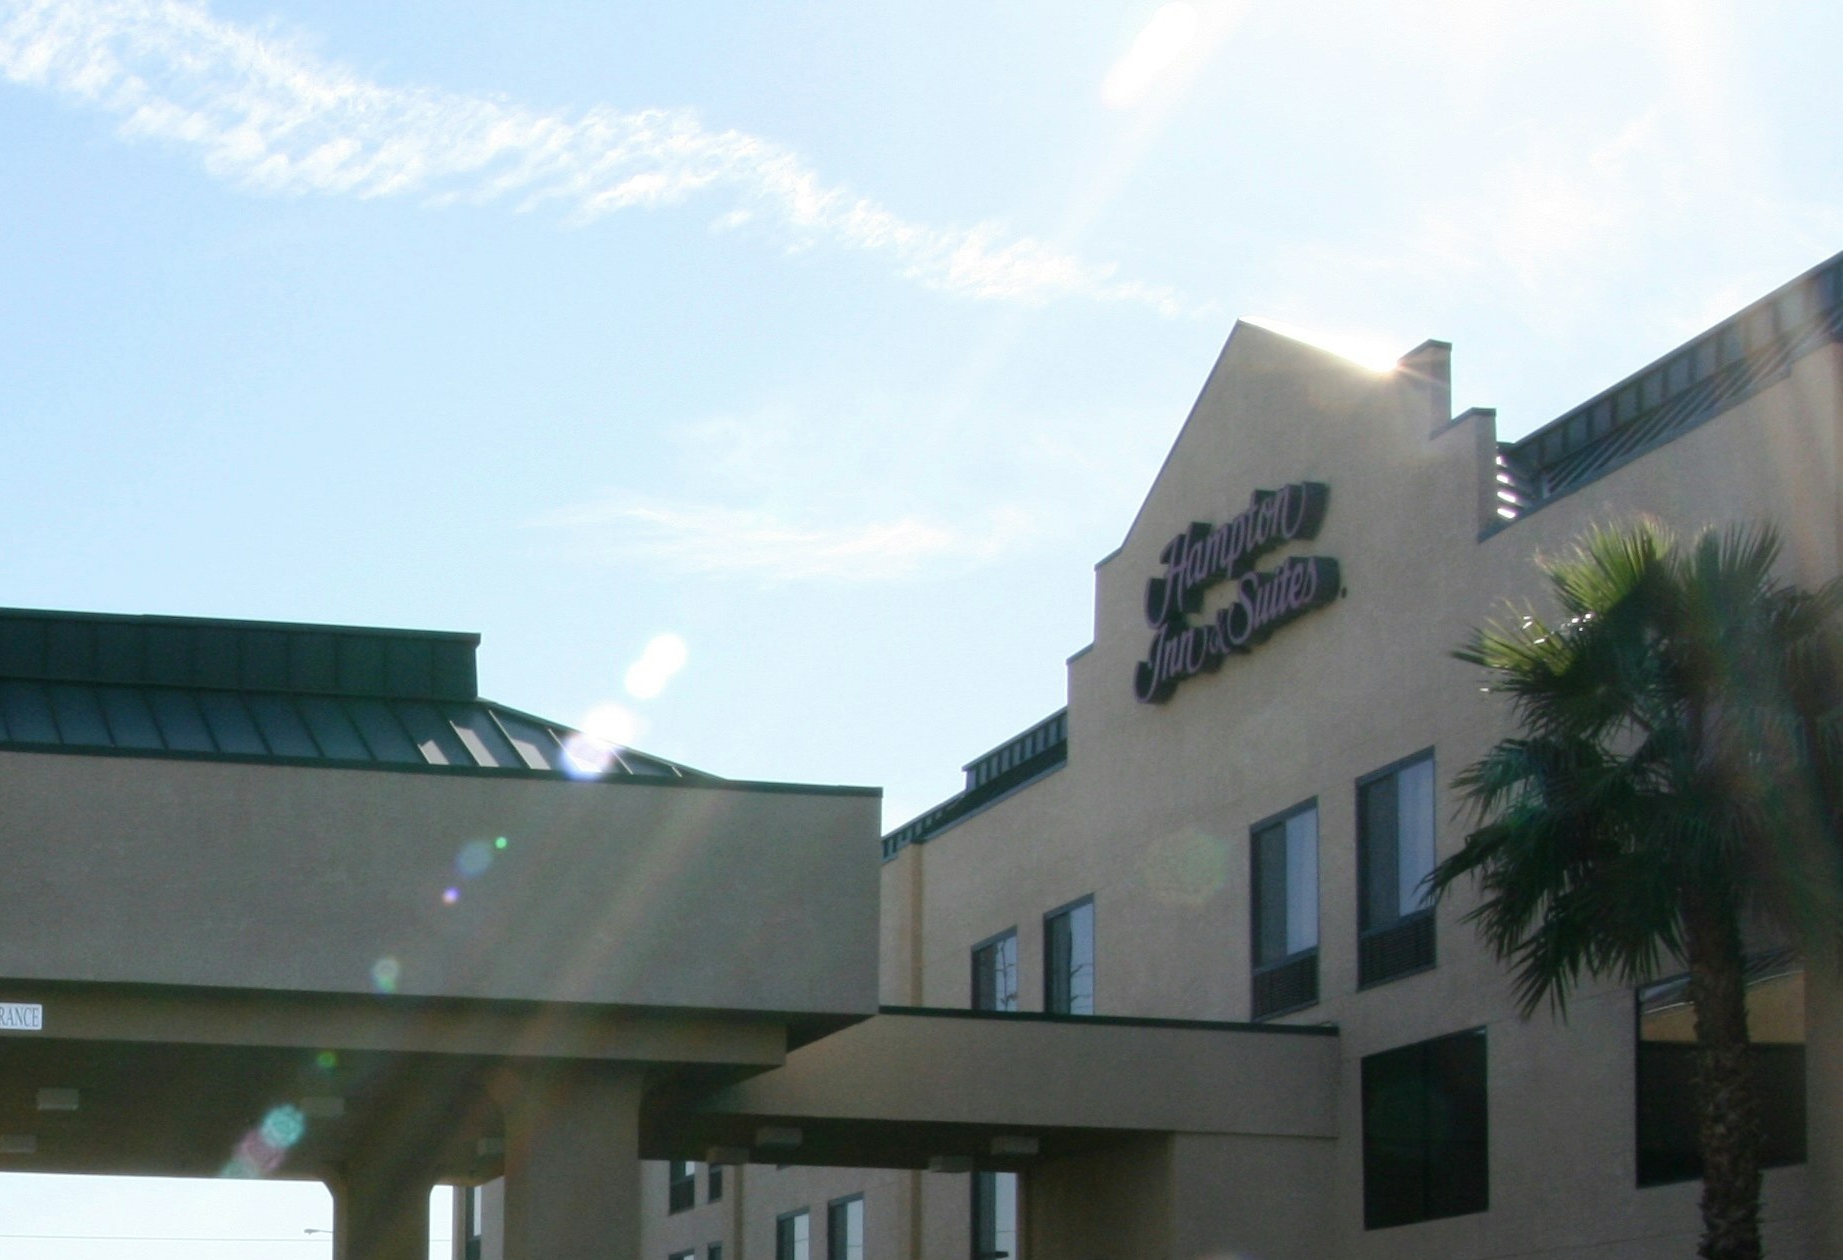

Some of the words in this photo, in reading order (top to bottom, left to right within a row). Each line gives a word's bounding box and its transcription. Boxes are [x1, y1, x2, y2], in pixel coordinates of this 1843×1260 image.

[1133, 622, 1208, 705] Inn
[1226, 555, 1341, 653] Suites
[1143, 480, 1331, 630] Hampton
